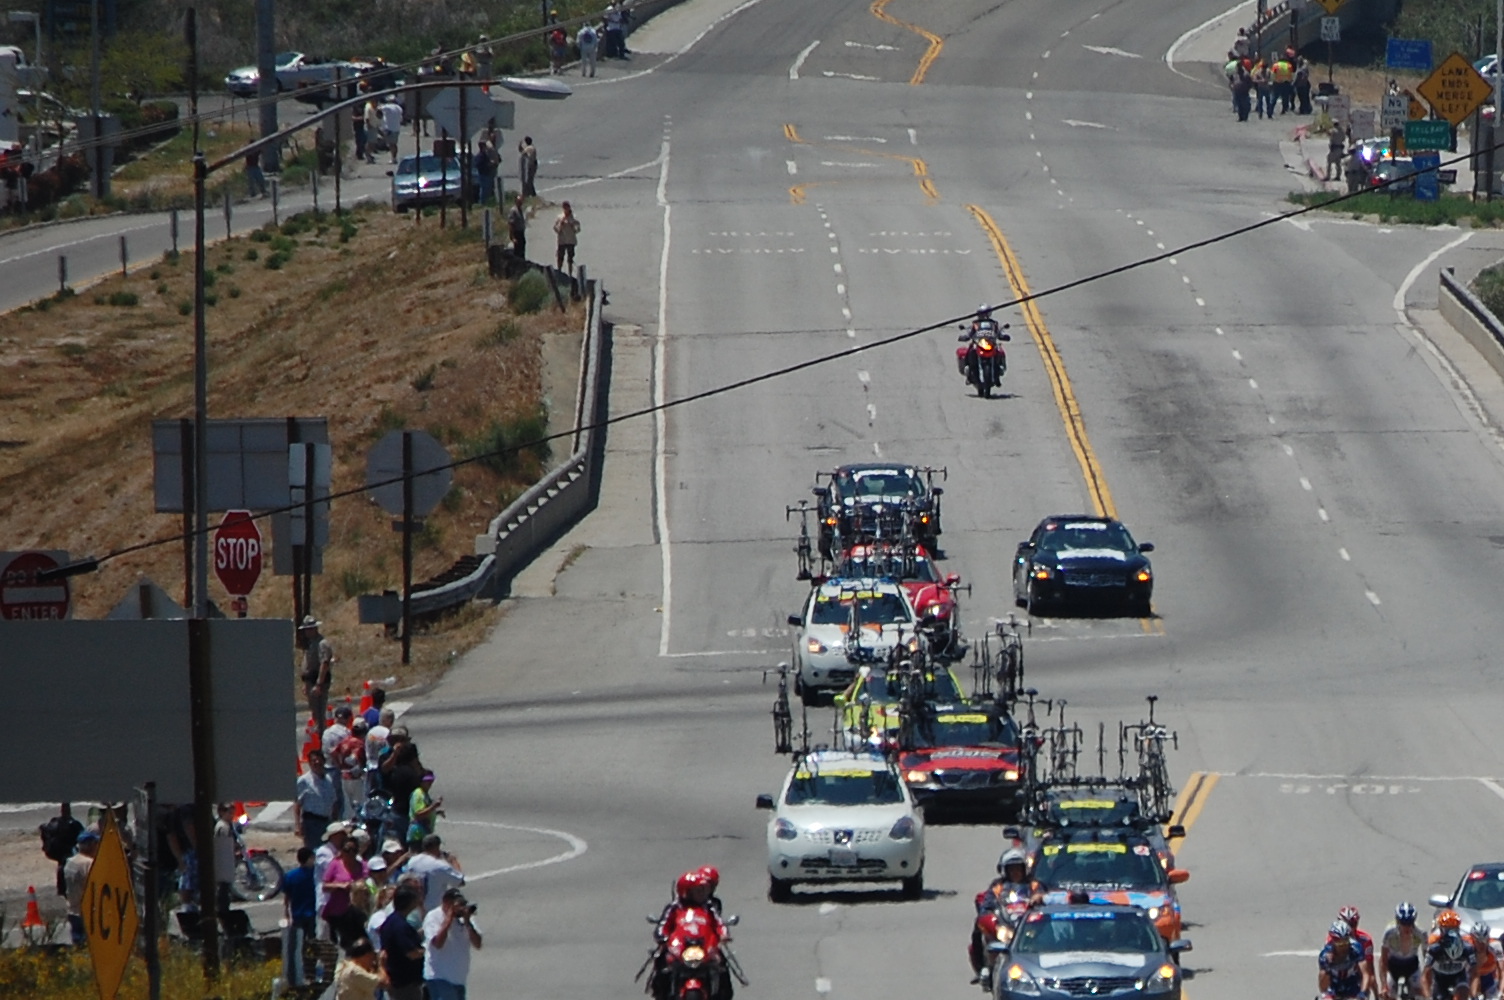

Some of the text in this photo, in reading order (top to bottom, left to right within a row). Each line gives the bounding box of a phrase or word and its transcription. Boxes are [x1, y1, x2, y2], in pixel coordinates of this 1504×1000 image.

[217, 537, 260, 570] STOP
[12, 607, 59, 620] ENTER
[89, 882, 129, 945] ICY
